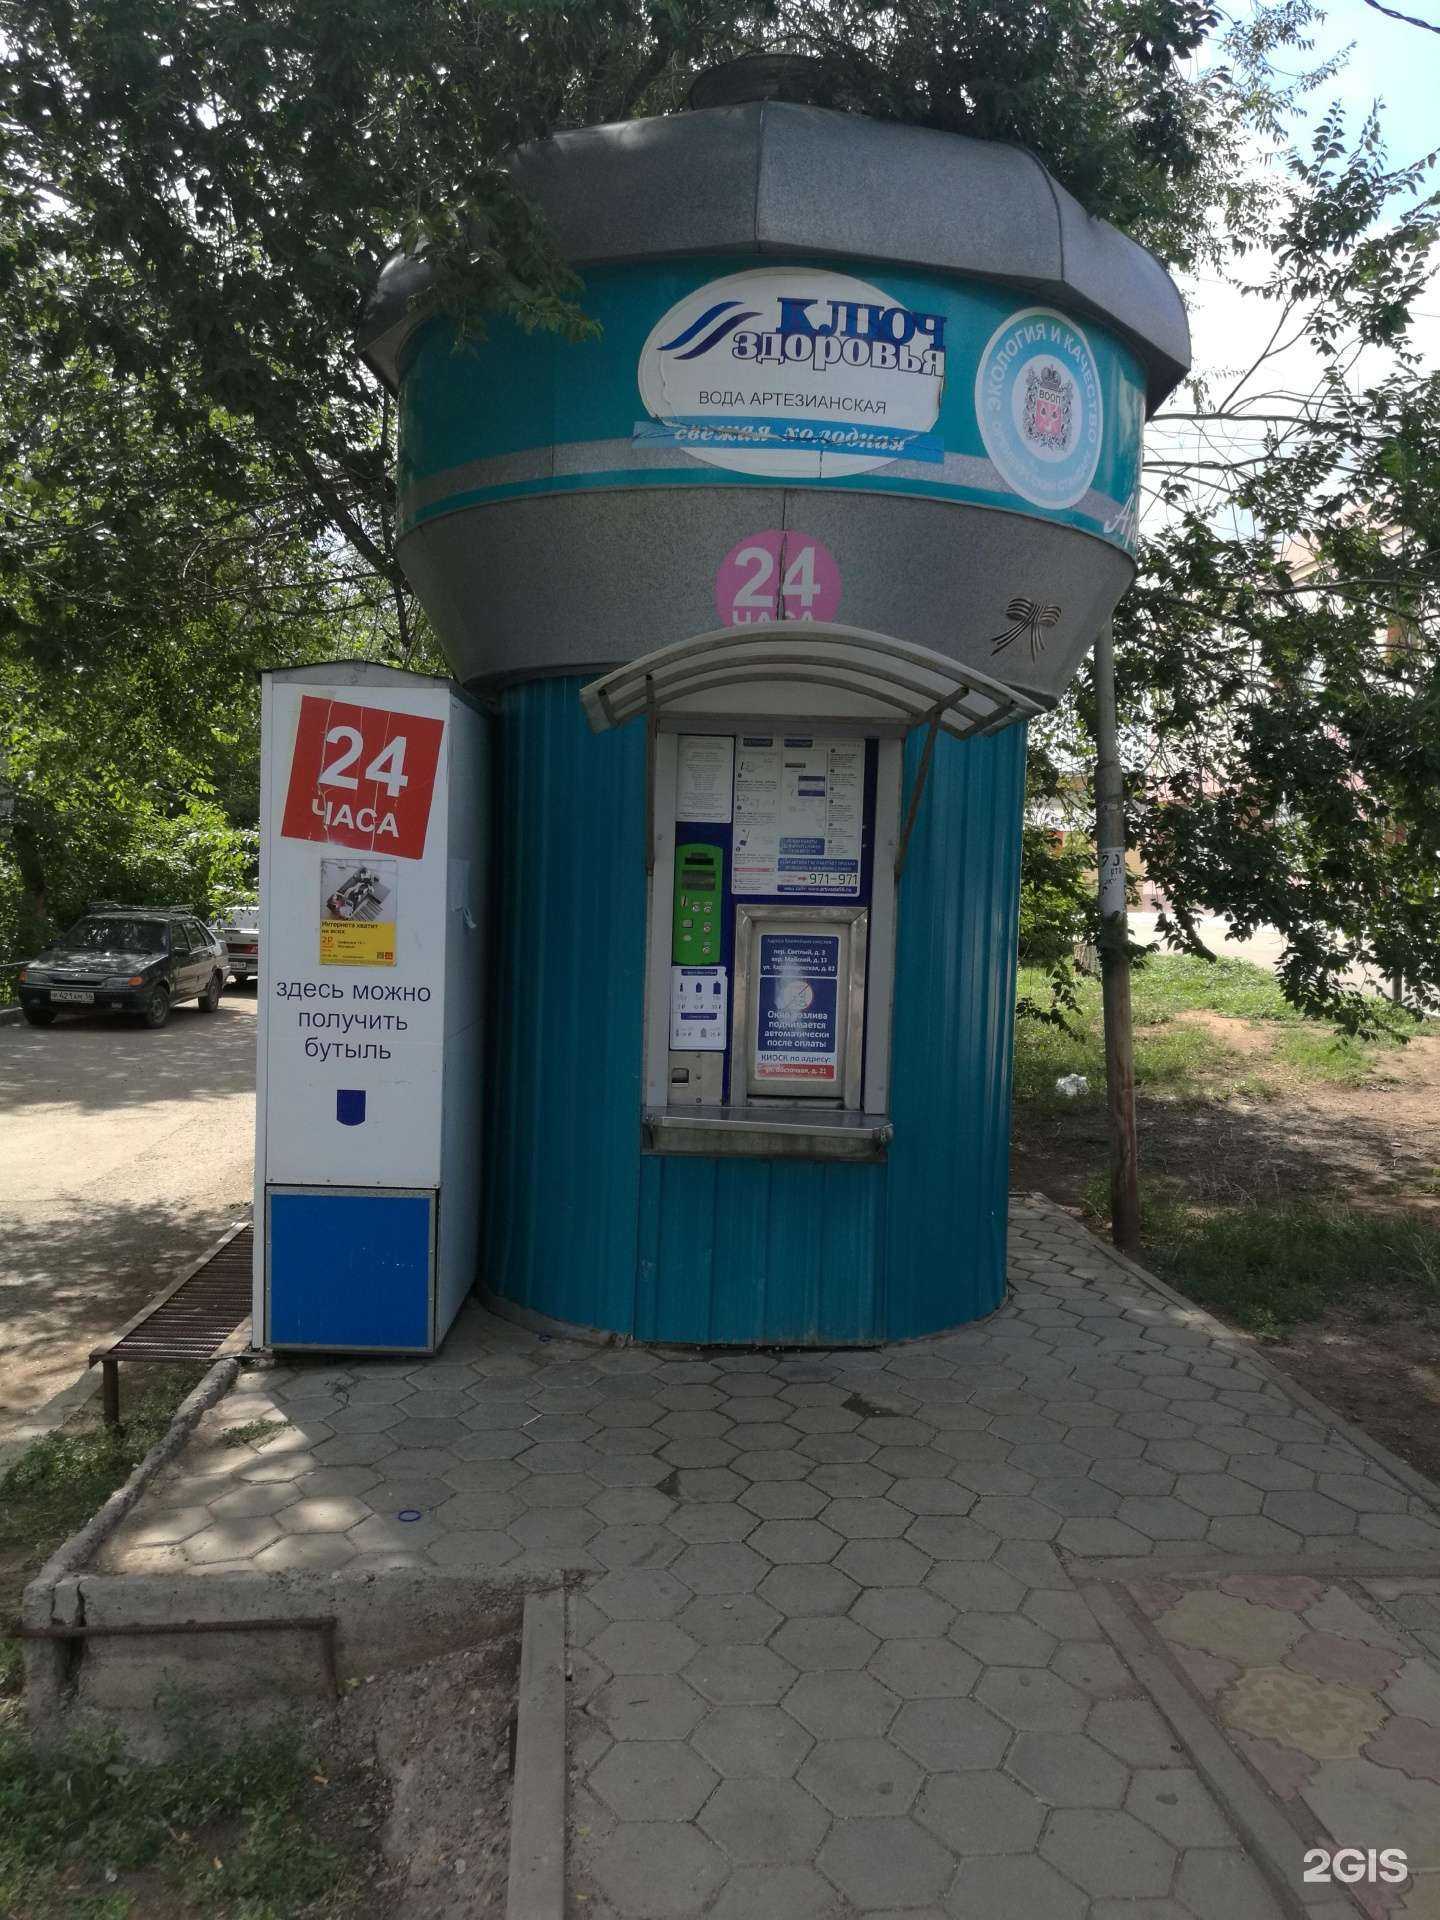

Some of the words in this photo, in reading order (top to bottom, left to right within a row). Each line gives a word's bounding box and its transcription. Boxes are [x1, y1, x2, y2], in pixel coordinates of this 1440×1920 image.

[986, 322, 1046, 411] ЭКОЛОГИЯ
[1051, 326, 1061, 343] И
[1064, 337, 1098, 443] КАЧЕСТВО
[699, 391, 745, 407] ВОДА
[750, 392, 886, 415] АРТЕЗИАНСКАЯ
[1039, 390, 1061, 403] ВООП
[734, 547, 821, 608] 24
[318, 726, 409, 798] 24
[312, 799, 400, 838] ЧАСА
[809, 873, 857, 886] 971-971
[276, 980, 344, 1000] здесь
[353, 984, 431, 1003] можно
[298, 1012, 408, 1038] получить
[764, 1031, 830, 1039] автоматически
[305, 1036, 392, 1063] бутыль
[767, 1039, 792, 1047] после
[794, 1040, 827, 1048] оплаты
